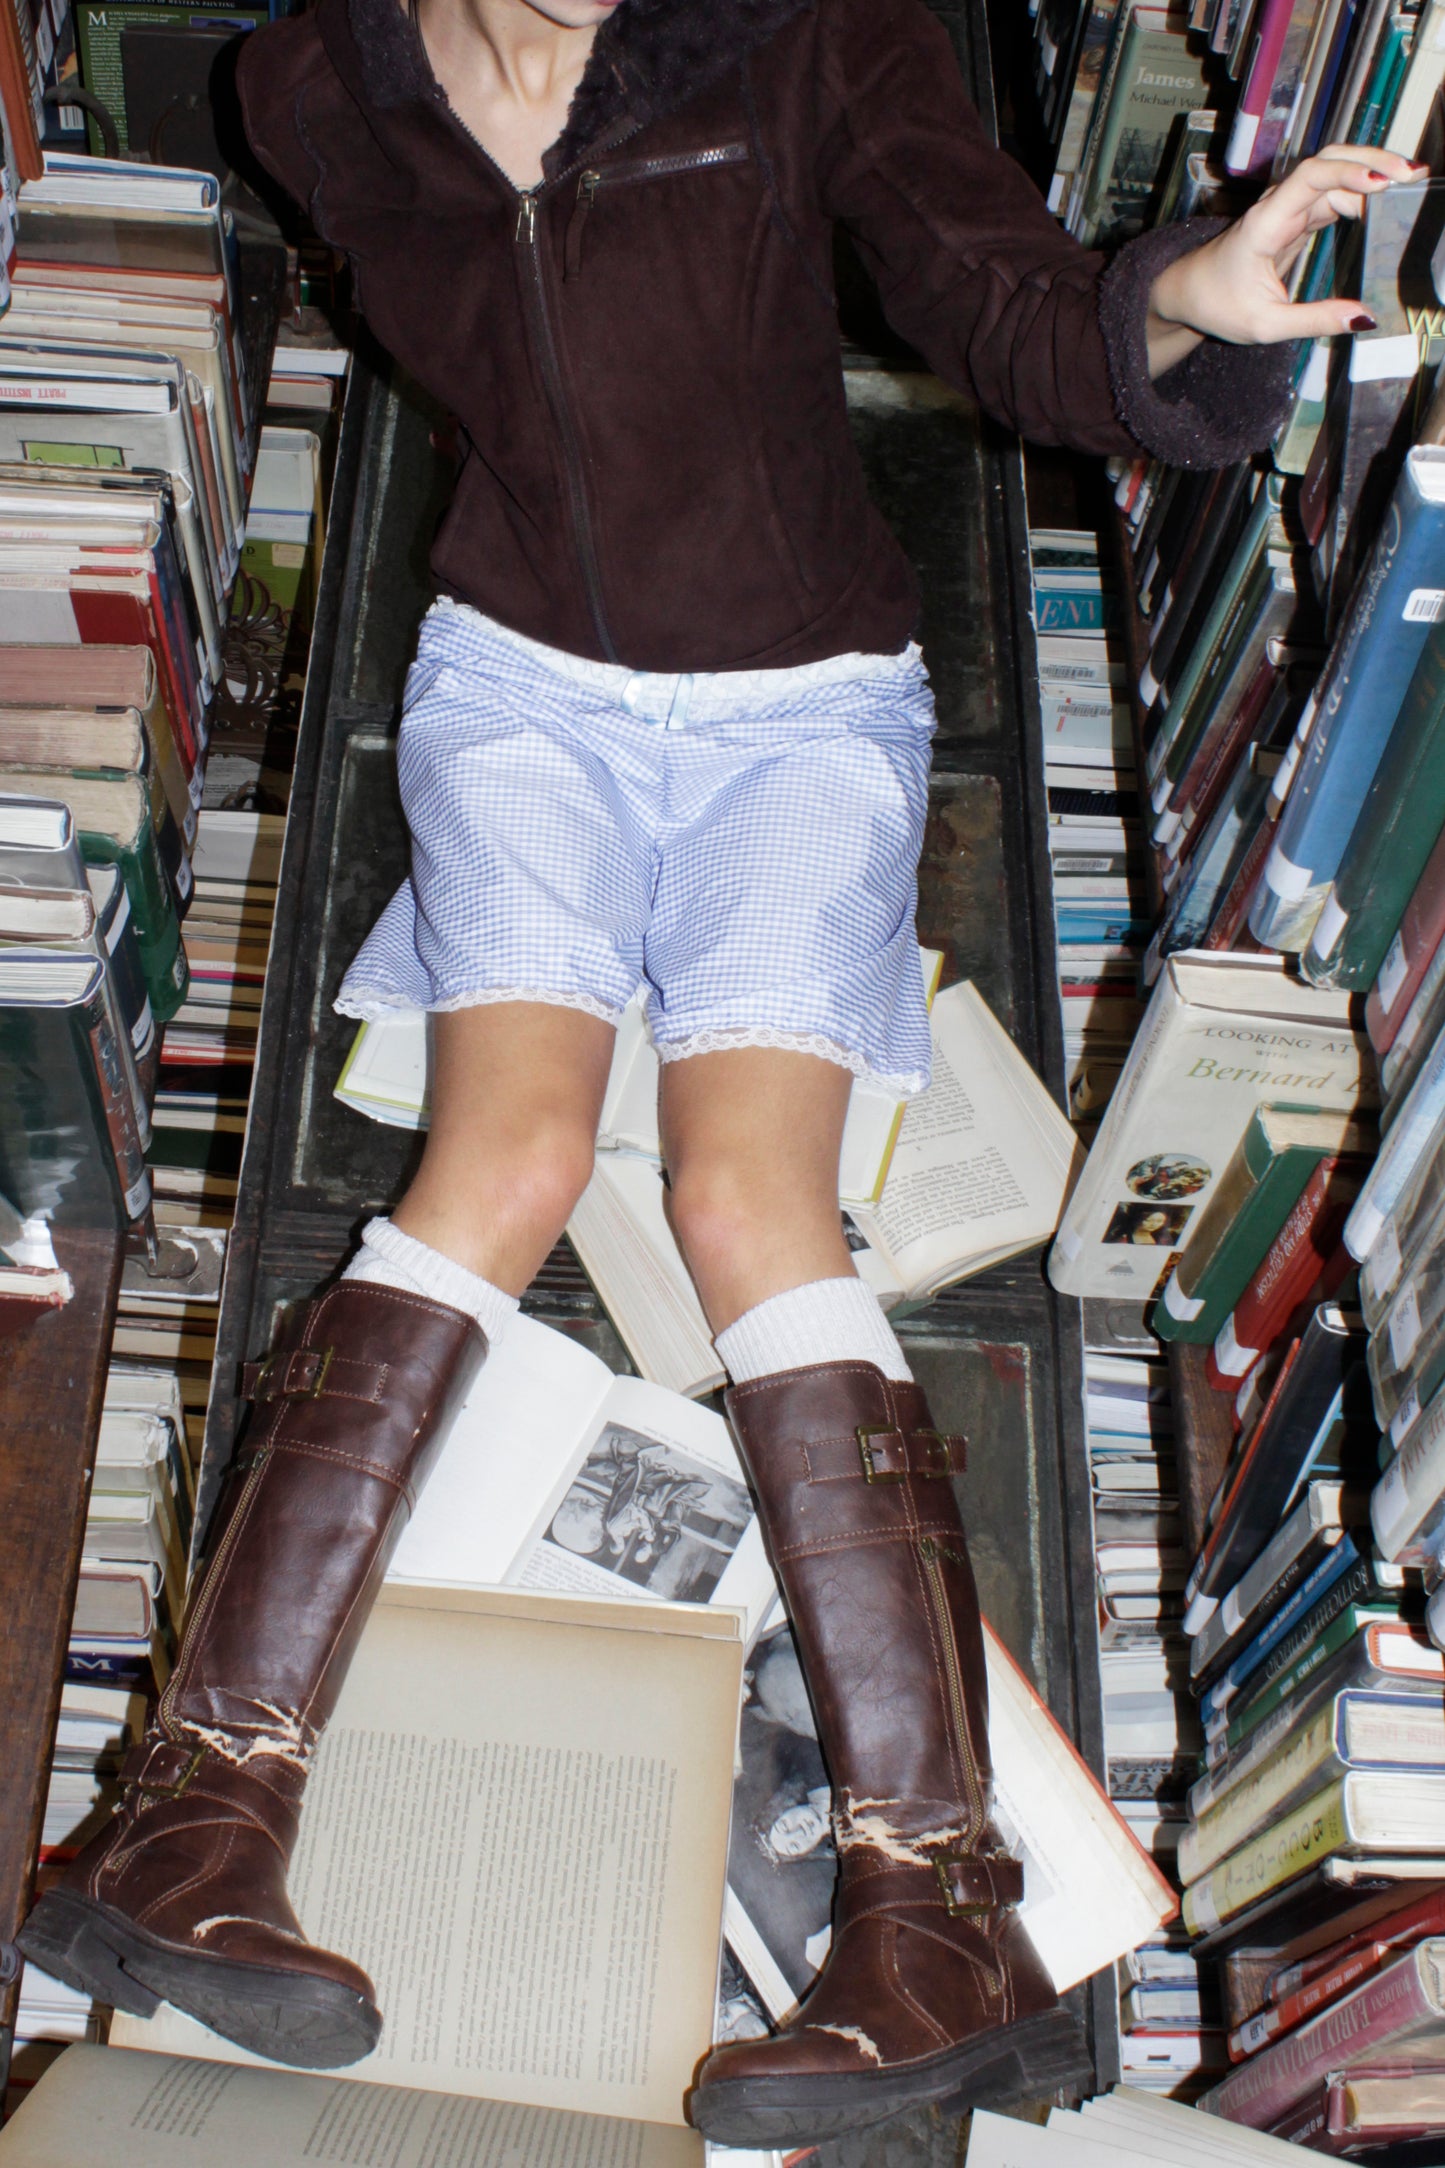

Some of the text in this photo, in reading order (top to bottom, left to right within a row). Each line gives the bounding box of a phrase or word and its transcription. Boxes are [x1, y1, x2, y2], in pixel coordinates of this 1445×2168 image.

[202, 1, 236, 9] PAINTING
[1134, 66, 1196, 90] James
[1129, 92, 1176, 106] Michael
[37, 388, 66, 399] PRATT
[1203, 1027, 1356, 1055] LOOKING AT
[1185, 1057, 1334, 1089] Bernard
[1323, 1997, 1371, 2048] EARLY
